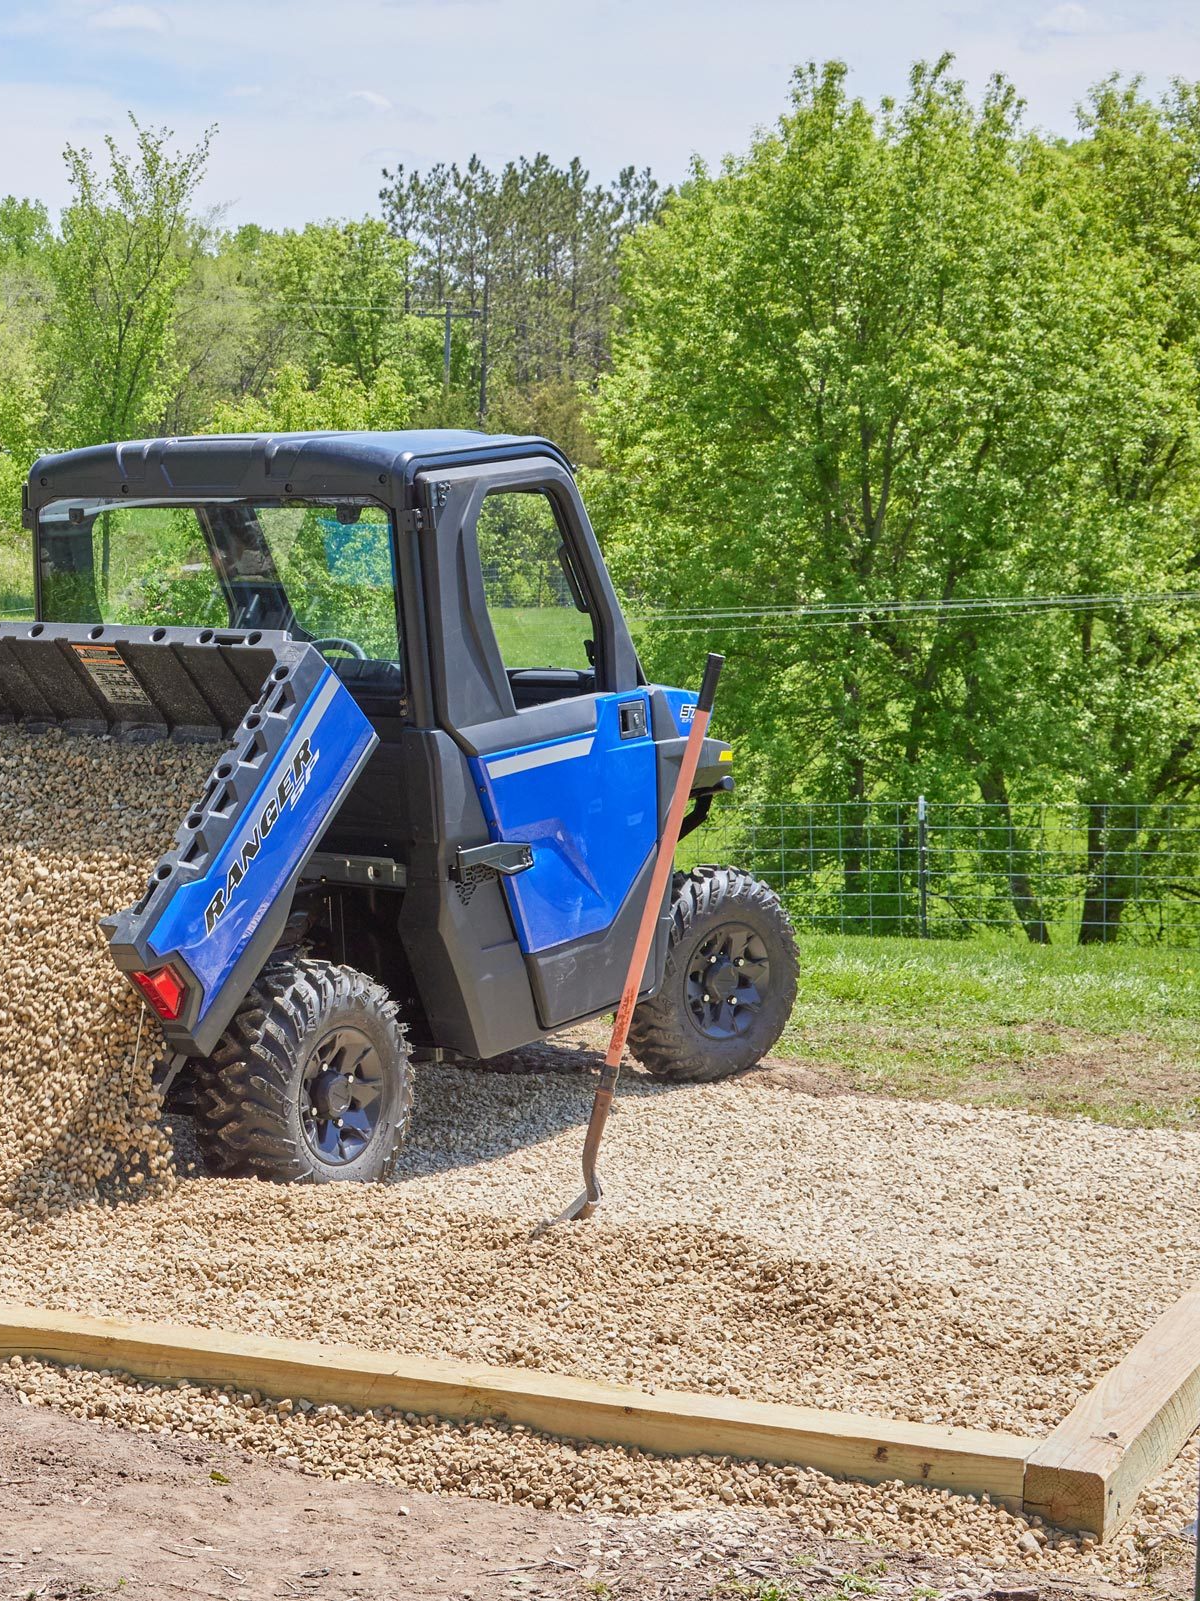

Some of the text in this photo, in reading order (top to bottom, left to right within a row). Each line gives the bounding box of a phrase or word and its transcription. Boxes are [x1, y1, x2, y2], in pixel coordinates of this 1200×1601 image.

[680, 703, 698, 719] 57
[290, 748, 320, 812] SP
[204, 737, 313, 937] RANGER
